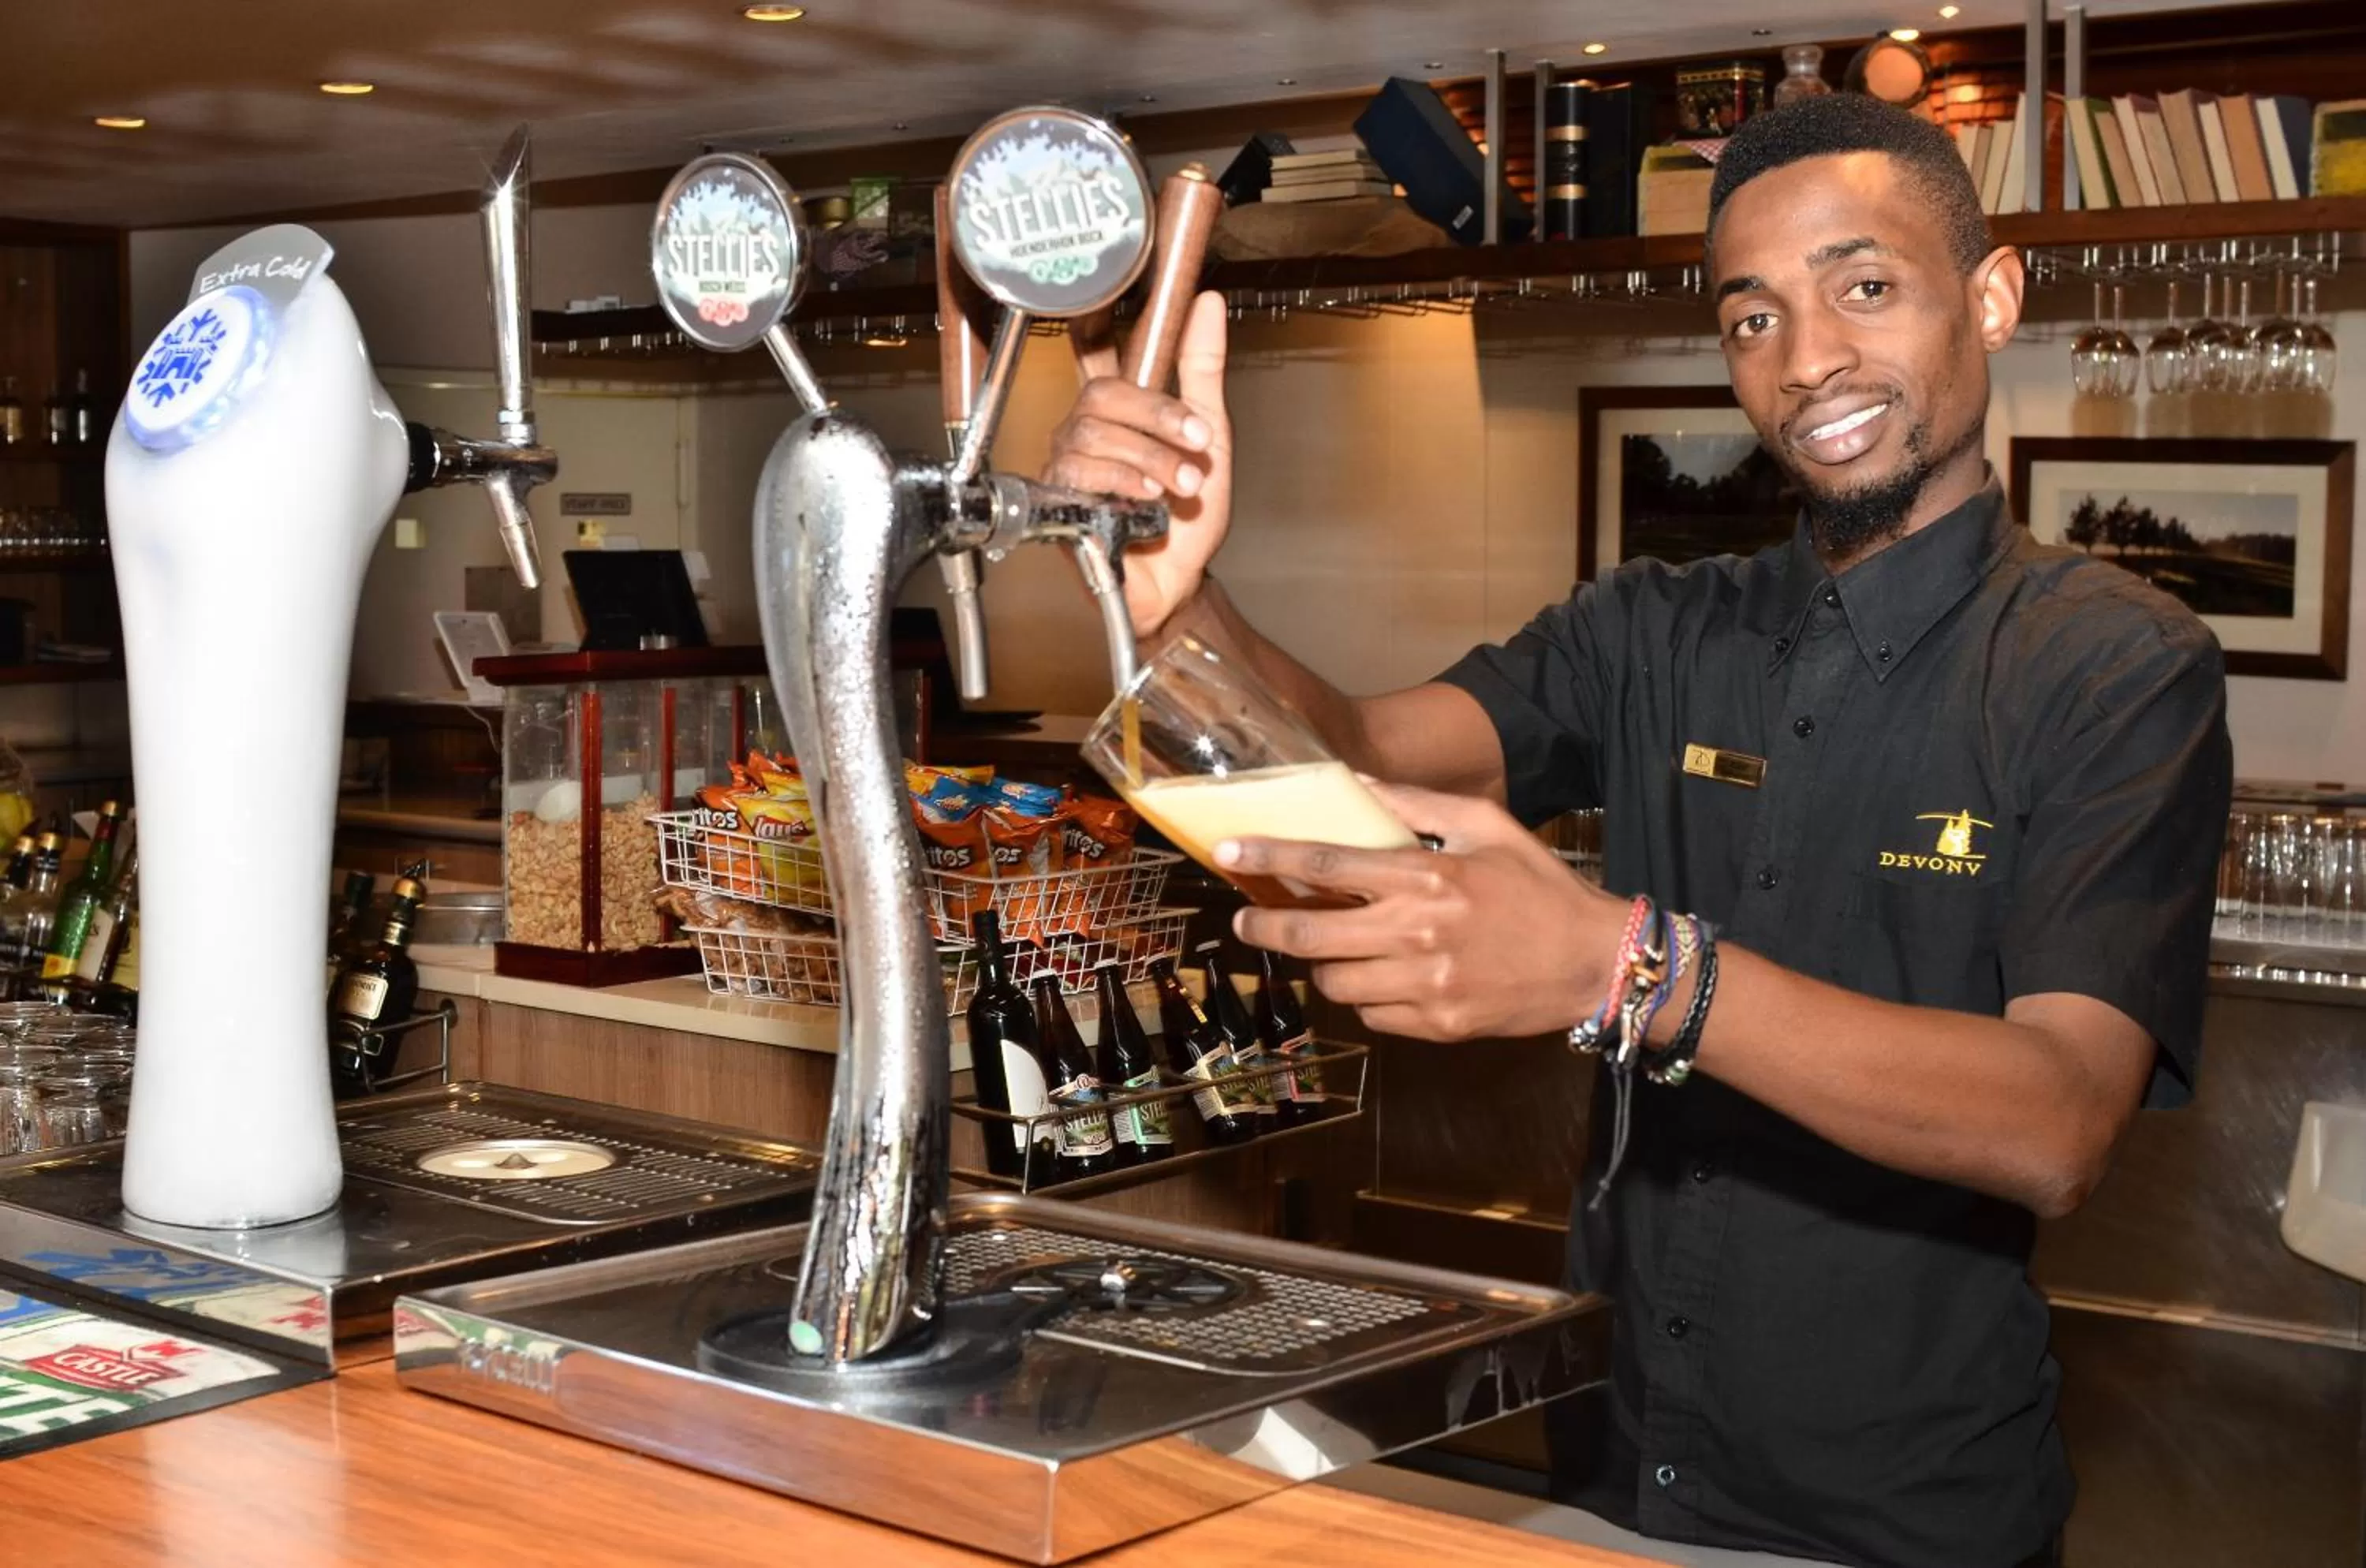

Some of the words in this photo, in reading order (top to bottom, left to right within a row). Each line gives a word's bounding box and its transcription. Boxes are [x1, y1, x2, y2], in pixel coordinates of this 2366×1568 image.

[969, 174, 1130, 252] STELLIES
[200, 263, 261, 293] Extra
[265, 256, 312, 279] Cold
[668, 228, 779, 278] STELLIES
[53, 1352, 160, 1385] CASTLE
